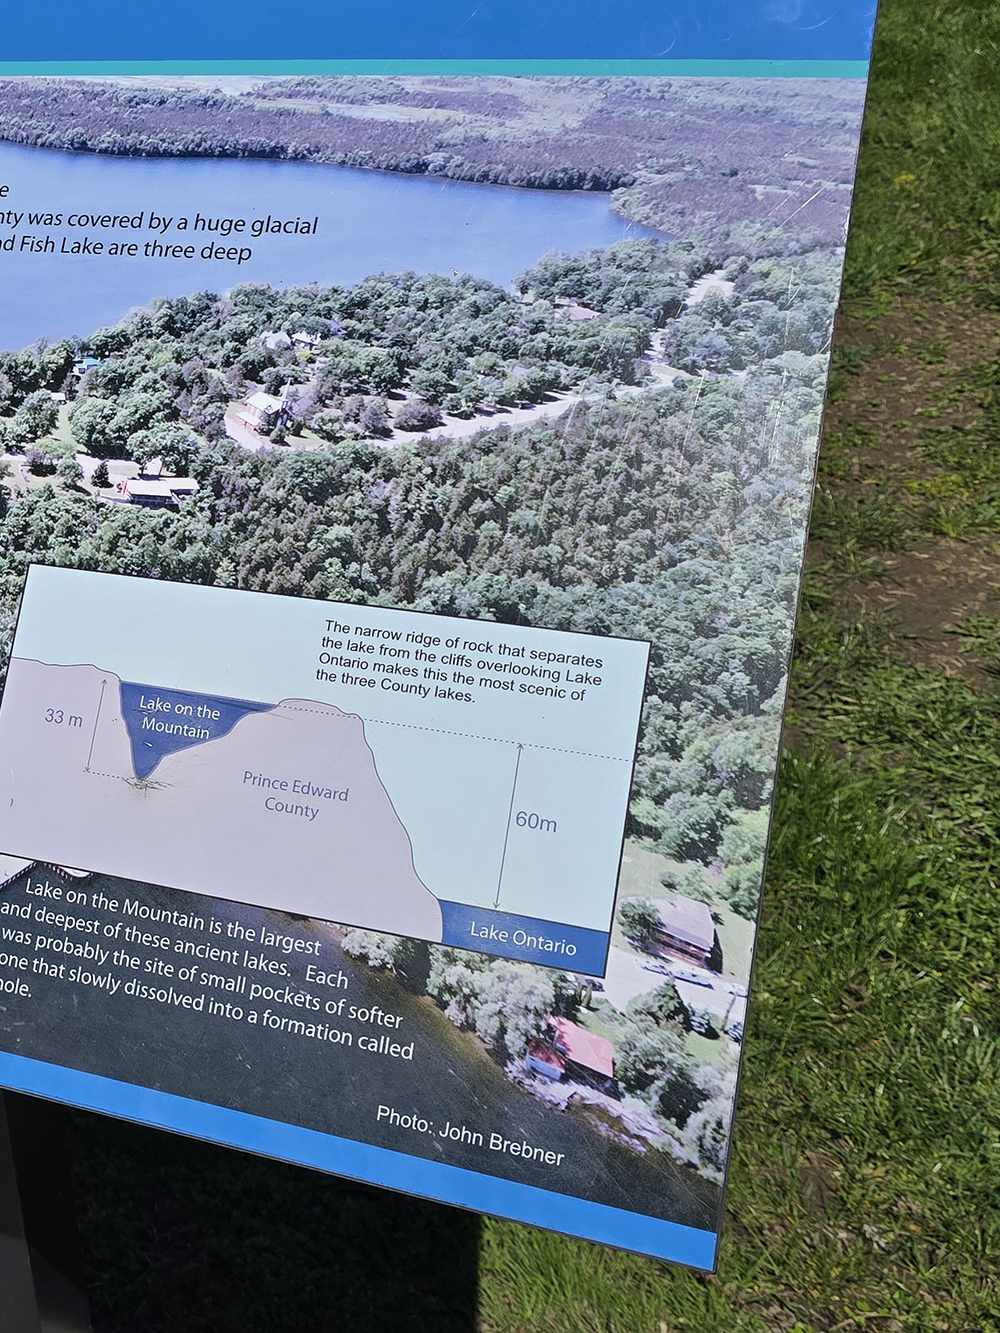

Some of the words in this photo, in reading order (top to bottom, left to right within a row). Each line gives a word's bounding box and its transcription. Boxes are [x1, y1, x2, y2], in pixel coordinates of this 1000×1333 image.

[20, 235, 55, 253] Fish
[61, 237, 104, 255] Lake
[108, 243, 138, 256] are
[144, 239, 195, 259] three
[200, 241, 252, 265] deep
[325, 619, 350, 634] The
[354, 626, 402, 641] narrow
[406, 632, 441, 648] ridge
[445, 637, 460, 649] of
[463, 641, 493, 654] rock
[498, 643, 525, 658] that
[529, 650, 603, 668] separates
[319, 652, 369, 670] Ontario
[373, 662, 419, 677] makes
[423, 667, 448, 681] this
[452, 671, 475, 685] the
[479, 678, 515, 692] most
[519, 683, 566, 699] scenic
[570, 689, 586, 701] of
[322, 636, 343, 650] the
[347, 639, 375, 654] lake
[379, 644, 410, 659] from
[415, 649, 436, 663] the
[441, 653, 472, 668] cliffs
[477, 660, 561, 683] overlooking
[566, 669, 602, 686] Lake
[316, 669, 337, 682] the
[341, 673, 376, 688] three
[381, 678, 431, 699] County
[434, 685, 475, 703] lakes.
[45, 709, 64, 724] 33
[68, 715, 83, 727] m
[139, 695, 171, 713] Lake
[174, 704, 193, 716] on
[197, 705, 221, 721] the
[142, 717, 210, 739] Mountain
[243, 771, 288, 791] Prince
[292, 780, 349, 802] Edward
[265, 797, 320, 821] County
[516, 811, 557, 832] 60m
[26, 878, 62, 900] Lake
[66, 891, 87, 905] on
[92, 892, 119, 912] the
[122, 898, 204, 930] Mountain
[209, 917, 222, 934] is
[227, 921, 256, 941] the
[260, 927, 322, 956] largest
[471, 921, 508, 942] Lake
[513, 930, 577, 956] Ontario
[2, 927, 32, 945] was
[35, 935, 110, 966] probably
[113, 949, 140, 969] the
[144, 960, 174, 977] site
[178, 965, 199, 982] of
[199, 972, 246, 994] small
[249, 984, 321, 1010] pockets
[325, 999, 347, 1016] of
[348, 1006, 404, 1029] softer
[377, 1105, 434, 1134] Photo:
[439, 1122, 483, 1146] John
[489, 1133, 565, 1166] Brebner
